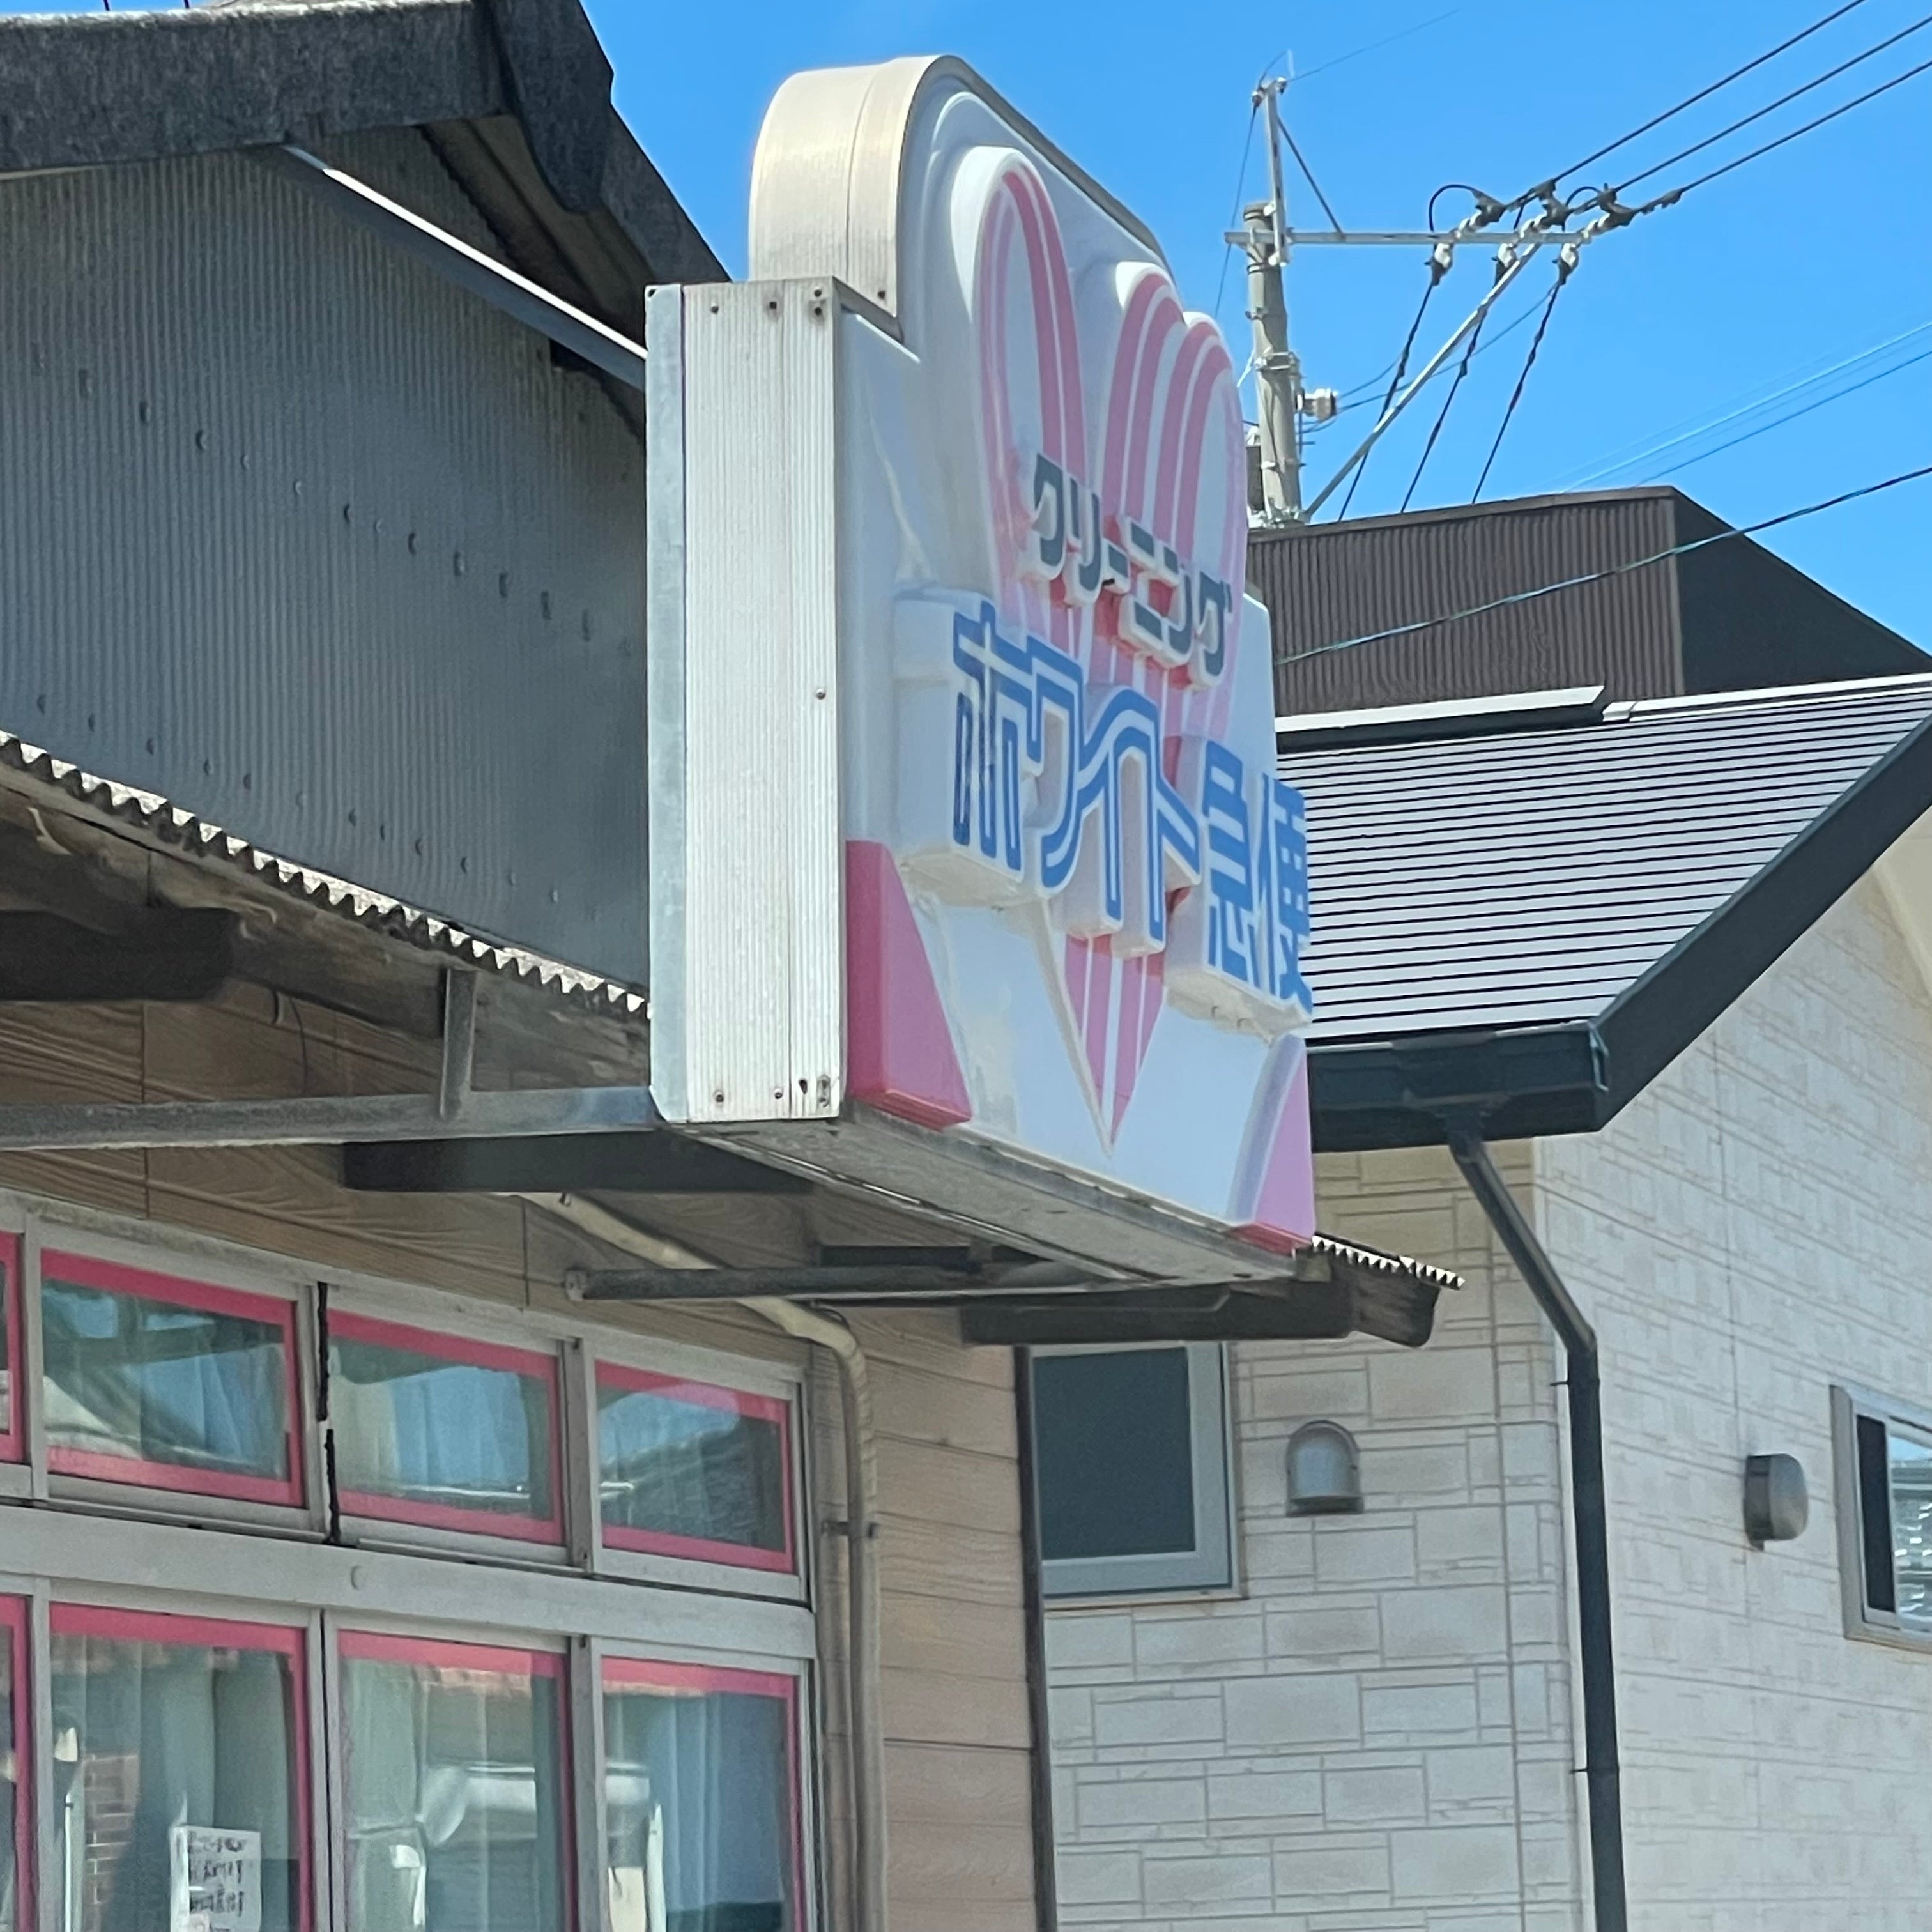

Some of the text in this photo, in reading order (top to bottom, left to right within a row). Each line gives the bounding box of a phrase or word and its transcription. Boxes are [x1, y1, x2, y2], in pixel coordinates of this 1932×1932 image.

[1033, 454, 1232, 676] クリーニング
[953, 601, 1312, 1015] ホワイト急便
